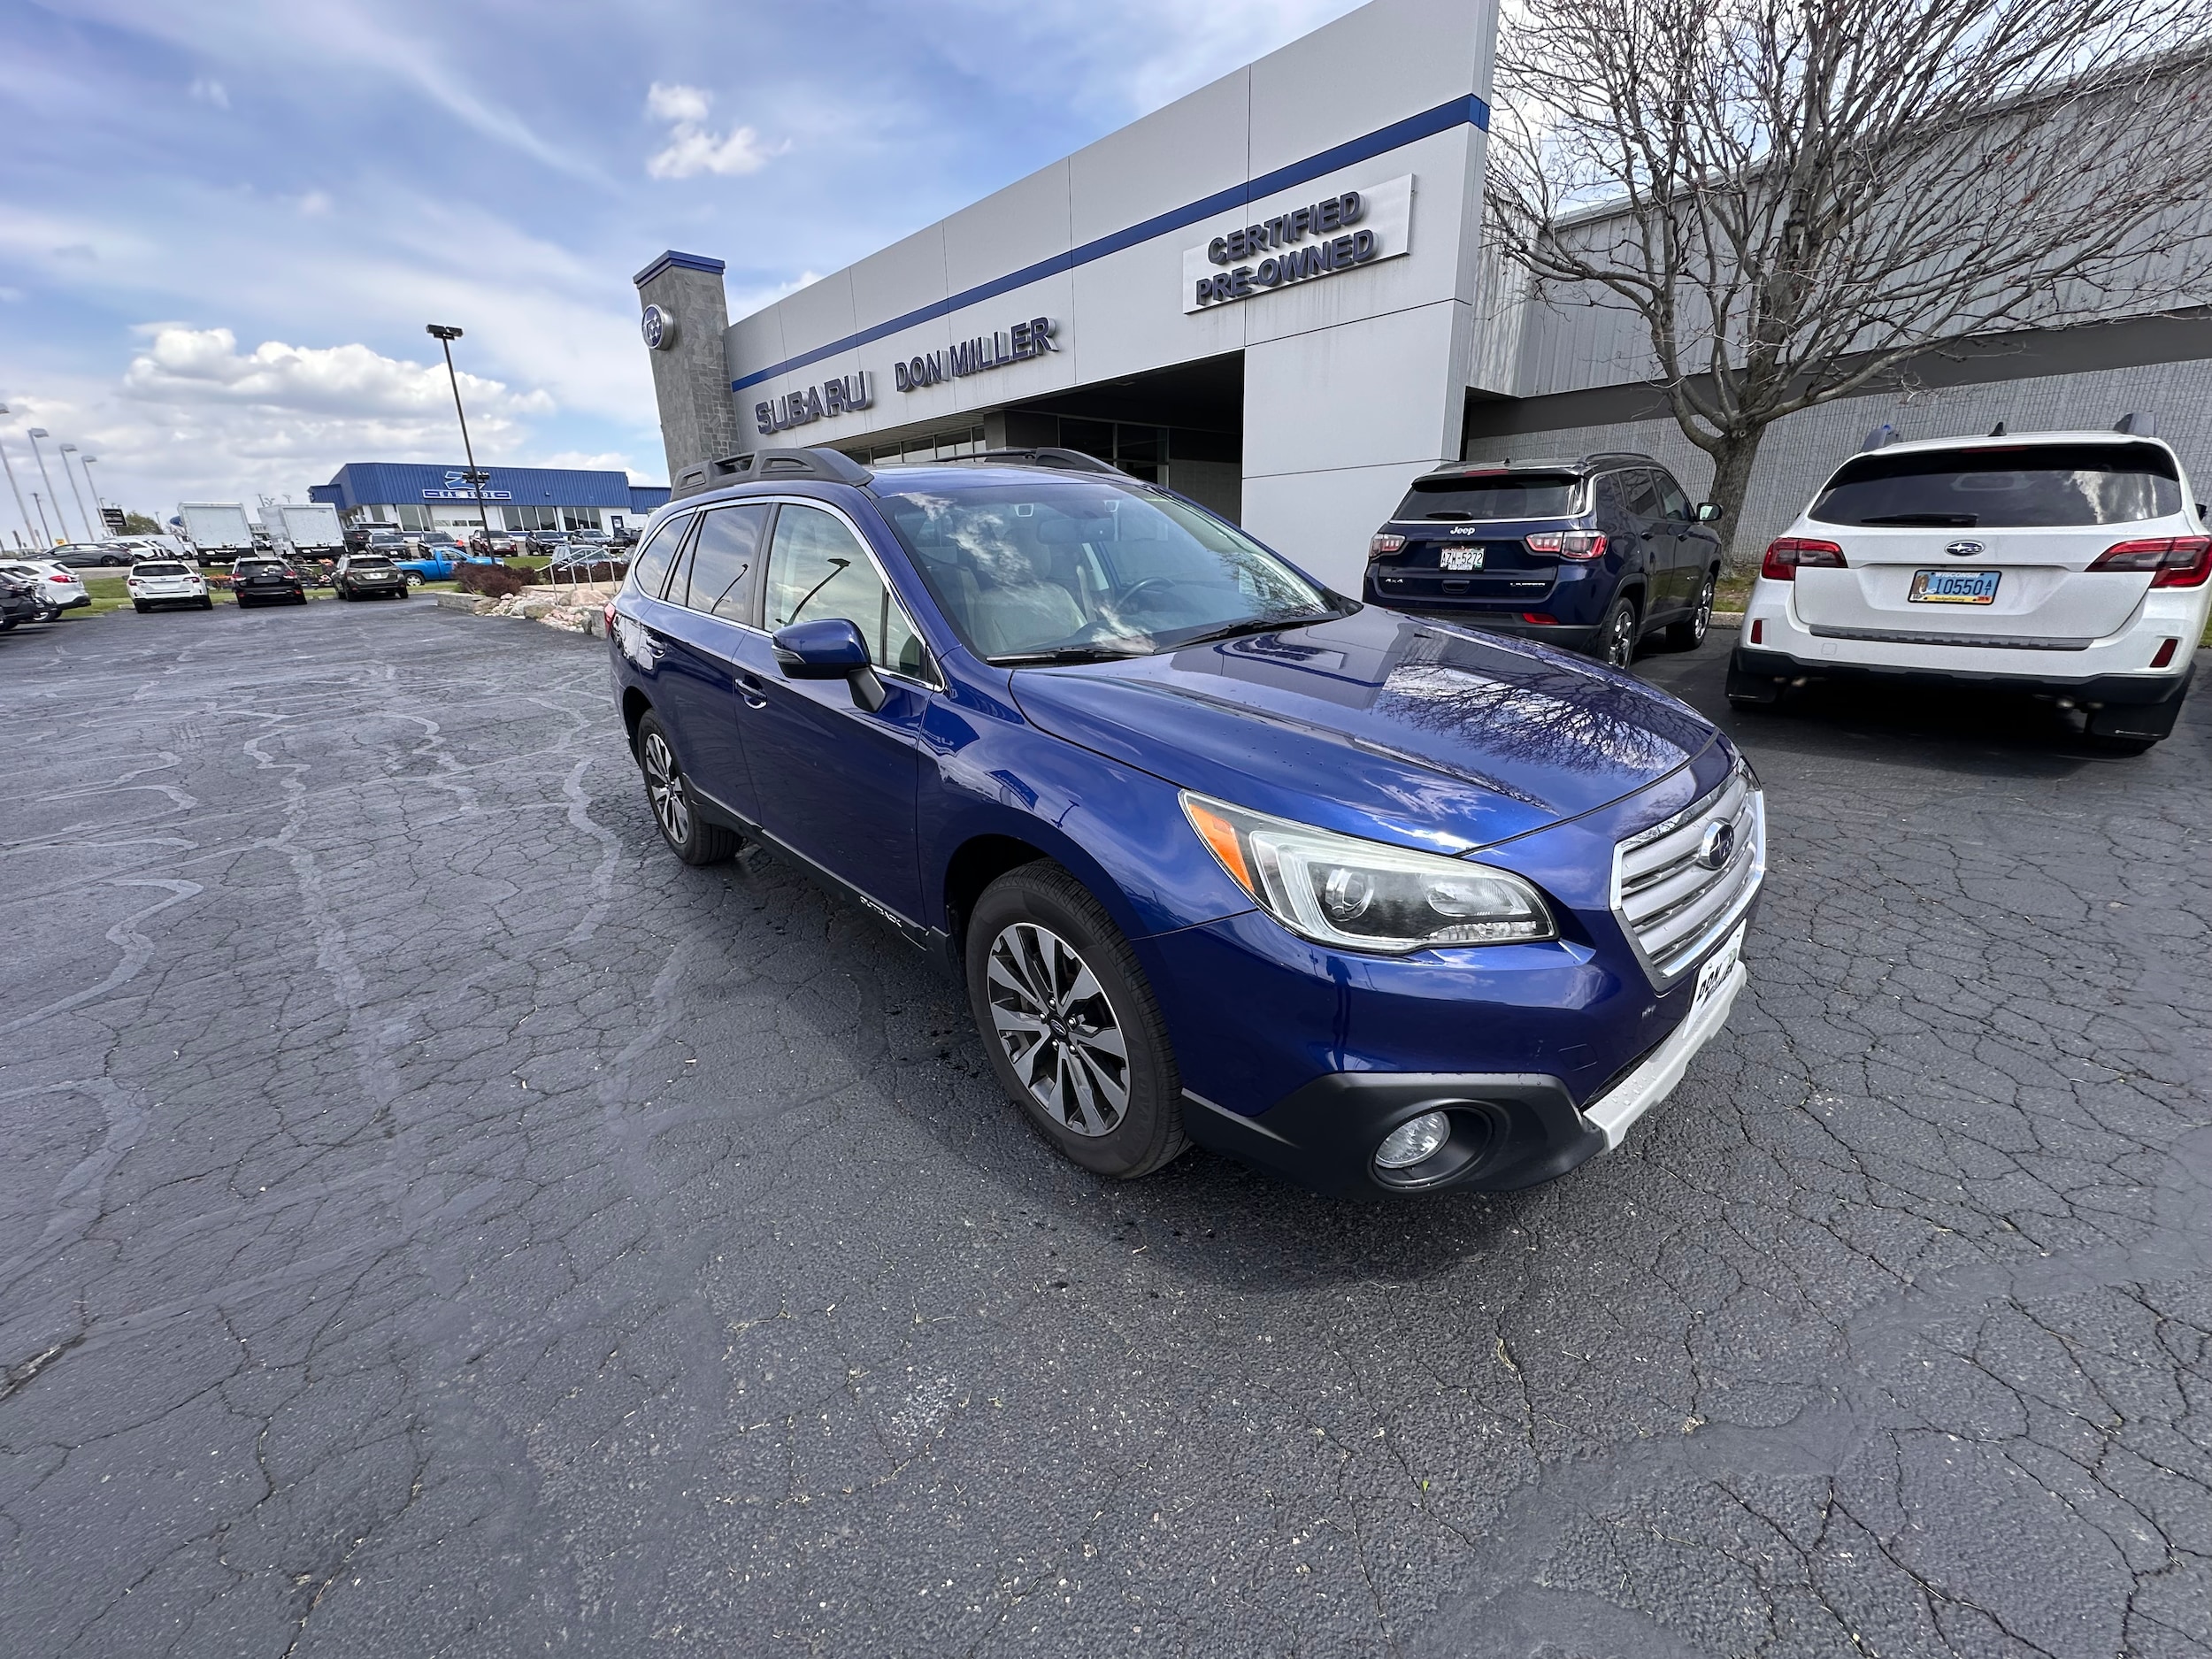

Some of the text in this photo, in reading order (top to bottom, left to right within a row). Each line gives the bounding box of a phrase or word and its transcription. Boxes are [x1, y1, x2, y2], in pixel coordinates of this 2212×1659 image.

[1208, 191, 1363, 265] CERTIFIED
[1196, 229, 1375, 305] PRE-OWNED
[895, 317, 1058, 392] DON MILLER
[755, 370, 870, 434] SUBARU
[1450, 526, 1475, 535] Jeep
[1934, 579, 1984, 595] 10550
